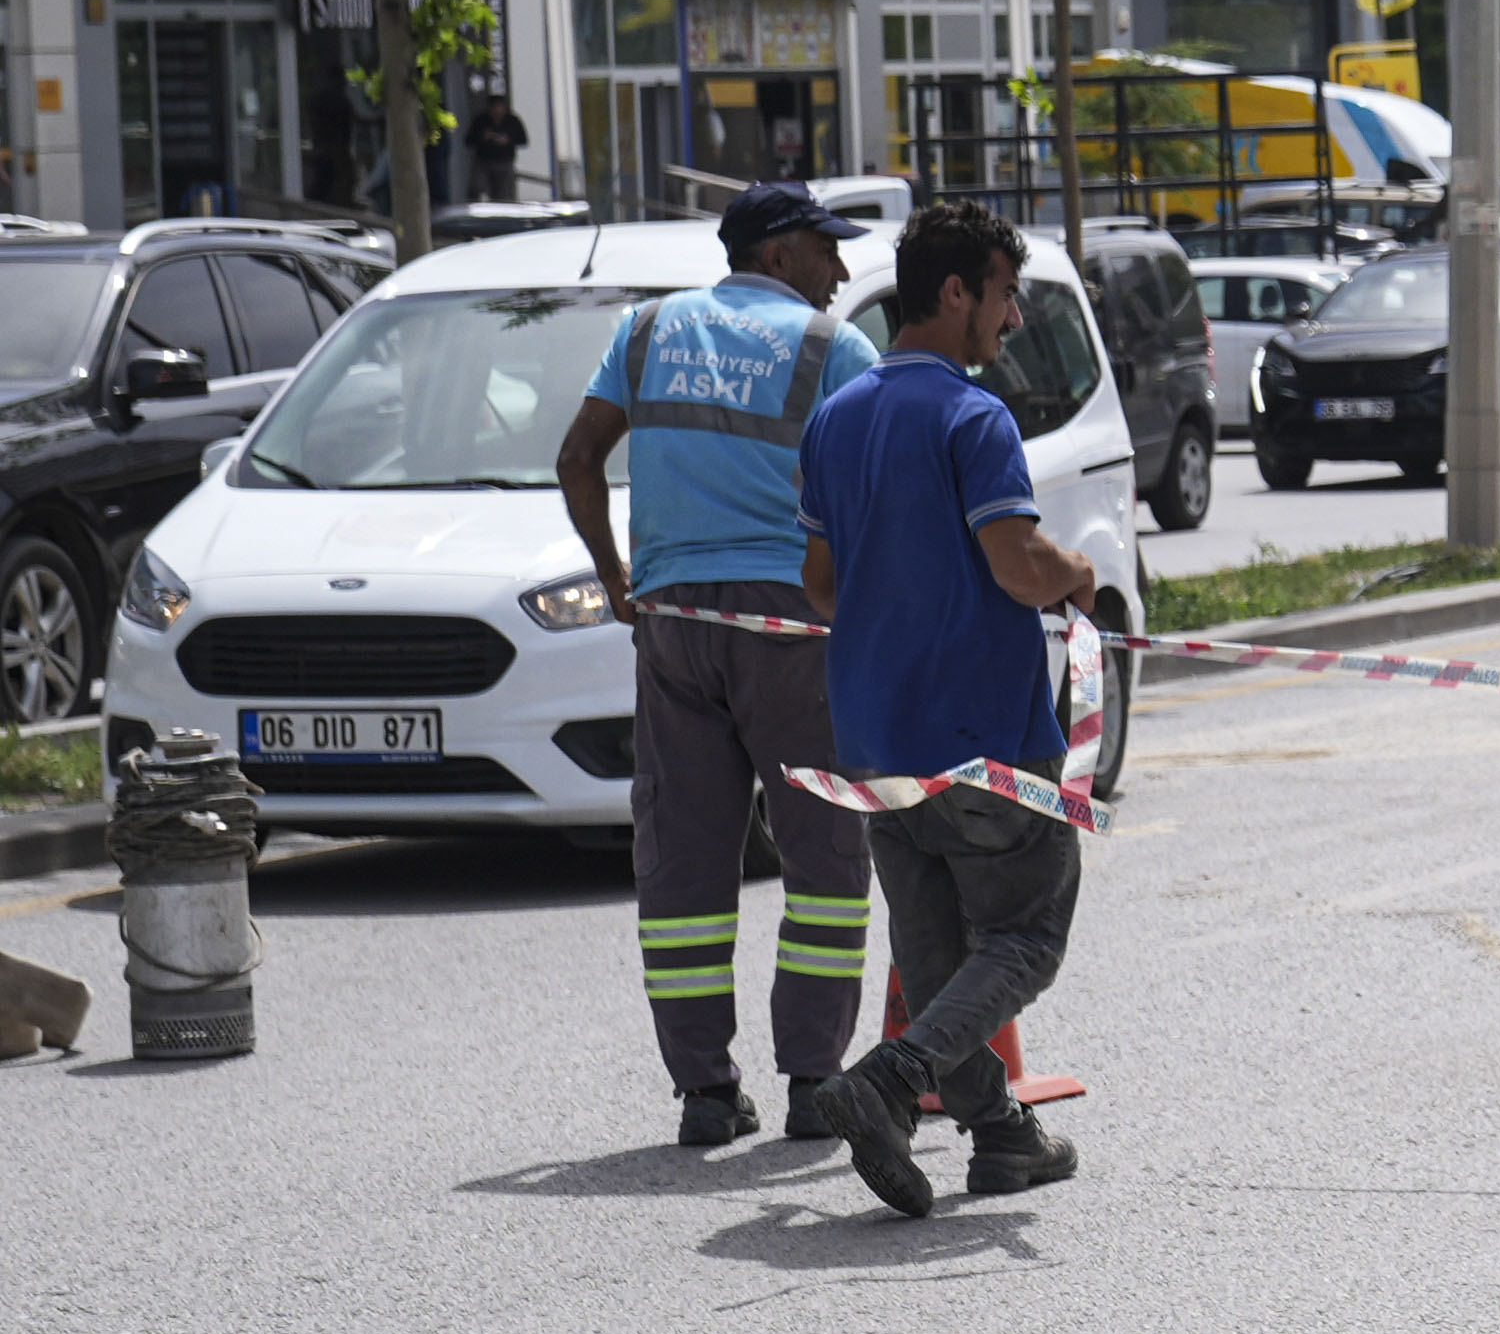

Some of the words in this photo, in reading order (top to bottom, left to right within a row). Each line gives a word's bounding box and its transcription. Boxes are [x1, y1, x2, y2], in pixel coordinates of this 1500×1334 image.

[658, 347, 776, 378] BELEDİYESİ
[665, 369, 754, 406] ASKİ
[260, 716, 295, 749] 06
[313, 716, 357, 749] DID
[383, 716, 433, 749] 871
